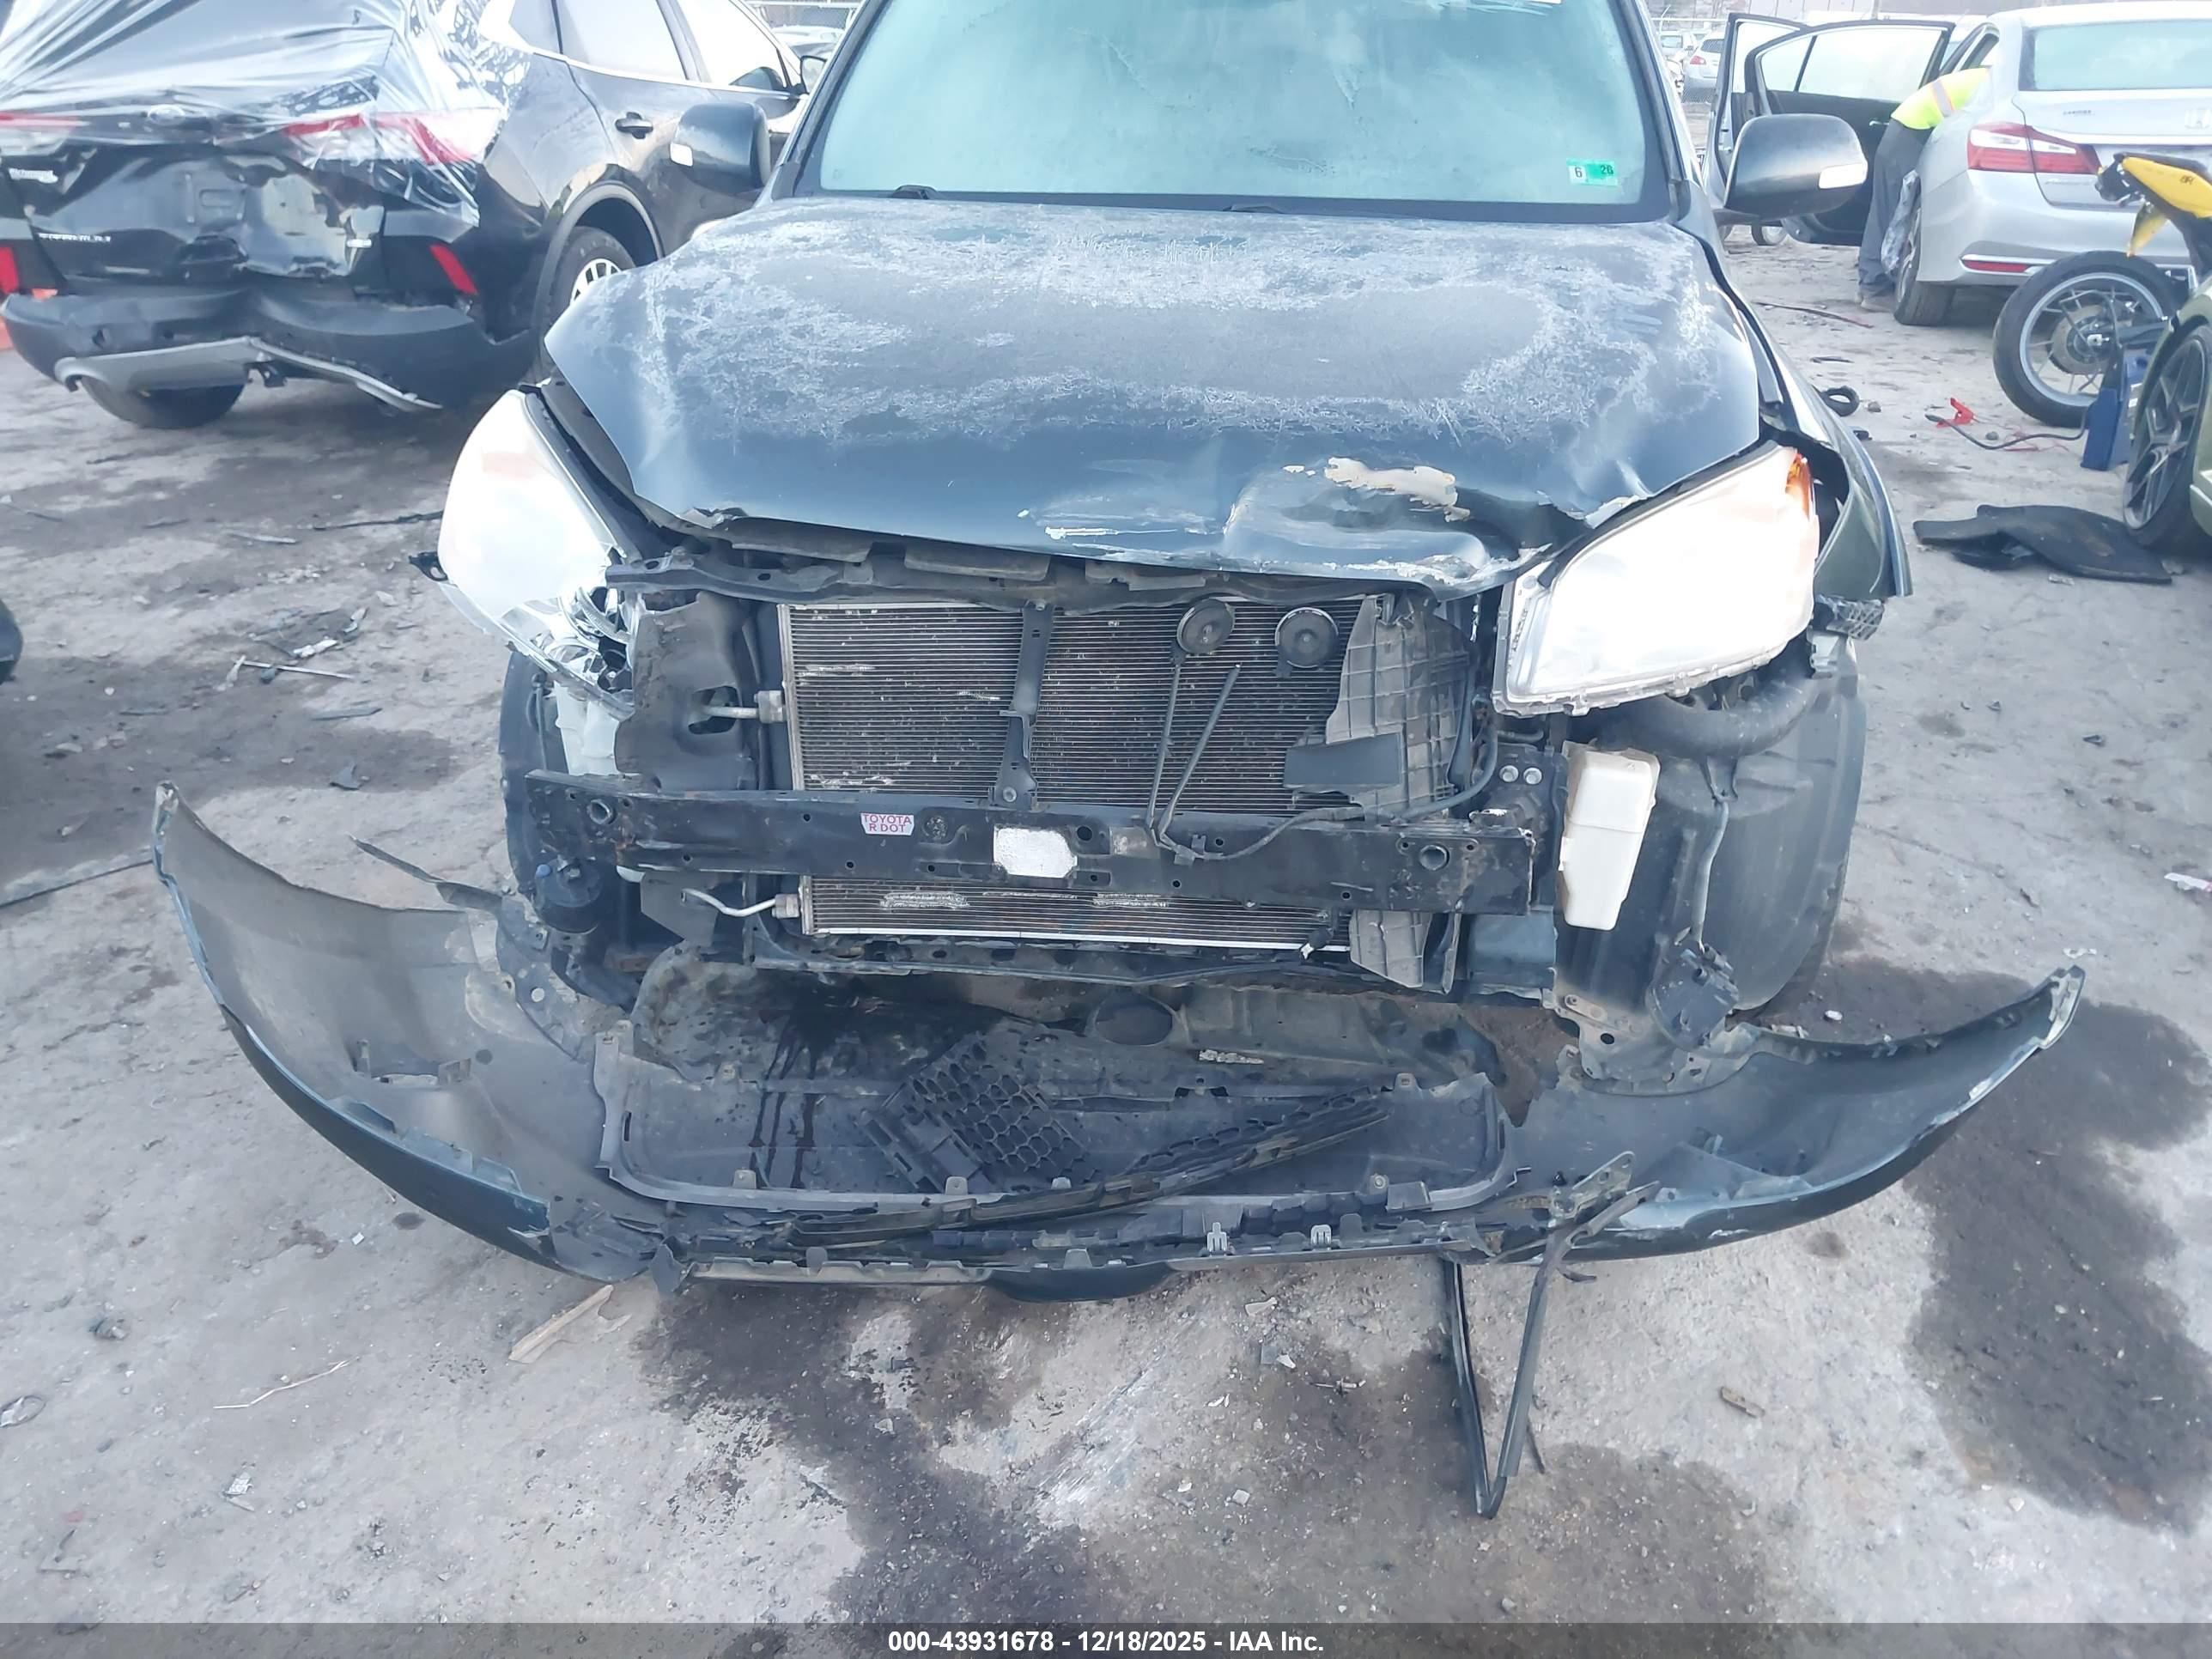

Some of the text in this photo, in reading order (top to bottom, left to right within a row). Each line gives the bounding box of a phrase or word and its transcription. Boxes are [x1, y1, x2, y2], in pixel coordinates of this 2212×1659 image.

[1574, 167, 1583, 178] 6
[863, 814, 912, 824] TOYOTA
[869, 823, 906, 833] R DOT
